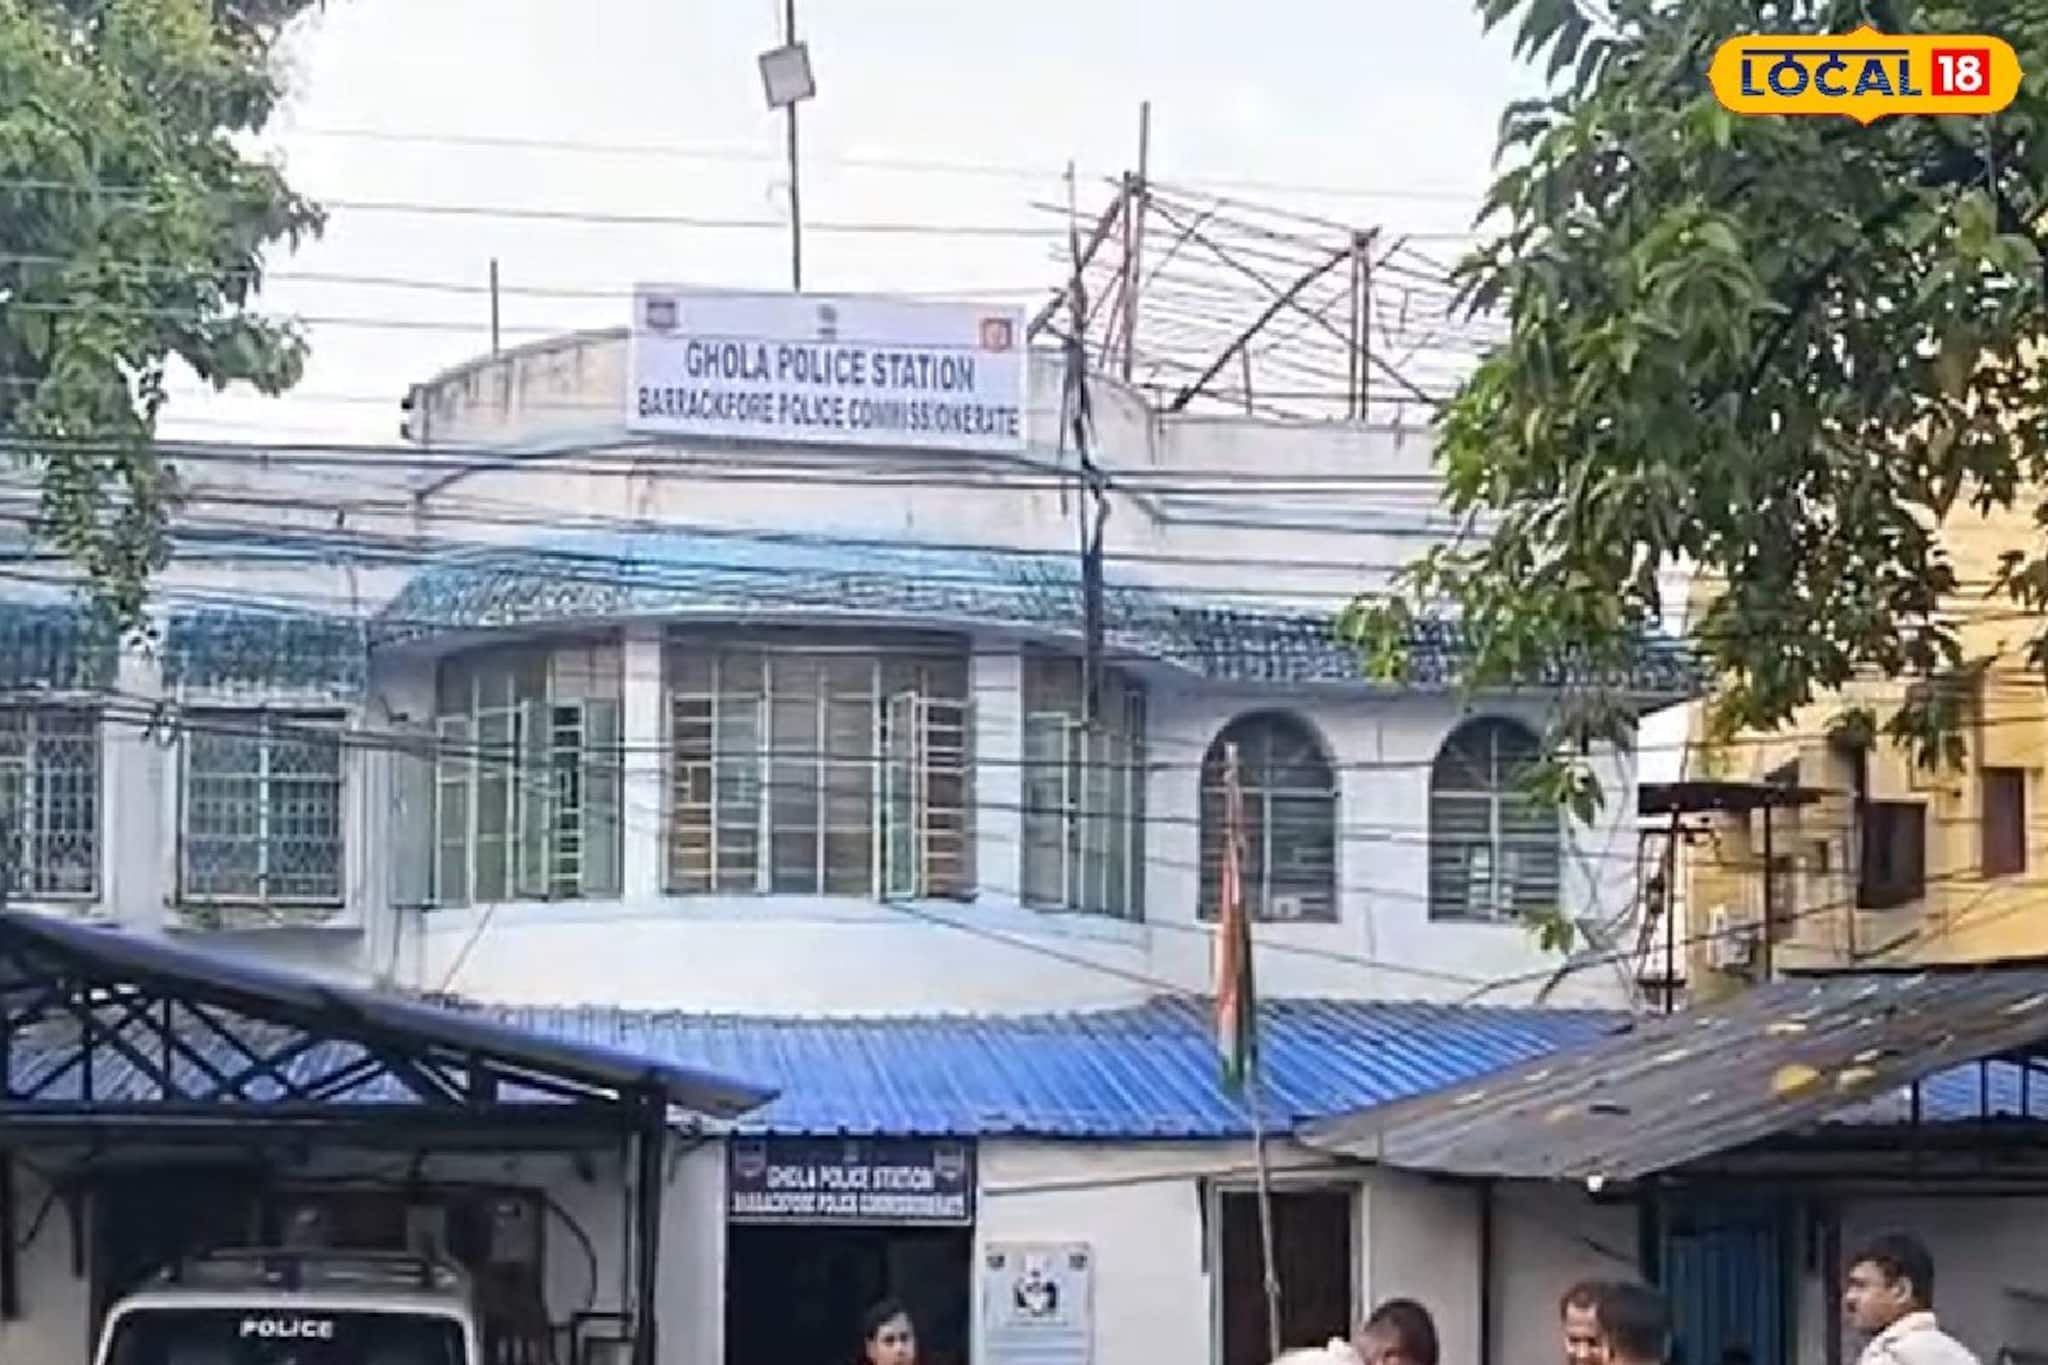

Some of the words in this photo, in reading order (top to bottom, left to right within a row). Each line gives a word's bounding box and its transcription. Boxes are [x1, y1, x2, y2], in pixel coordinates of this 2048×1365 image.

[686, 341, 770, 380] GHOLA
[778, 345, 866, 385] POLICE
[872, 353, 976, 392] STATION
[779, 393, 844, 428] POLICE
[240, 1319, 335, 1339] POLICE
